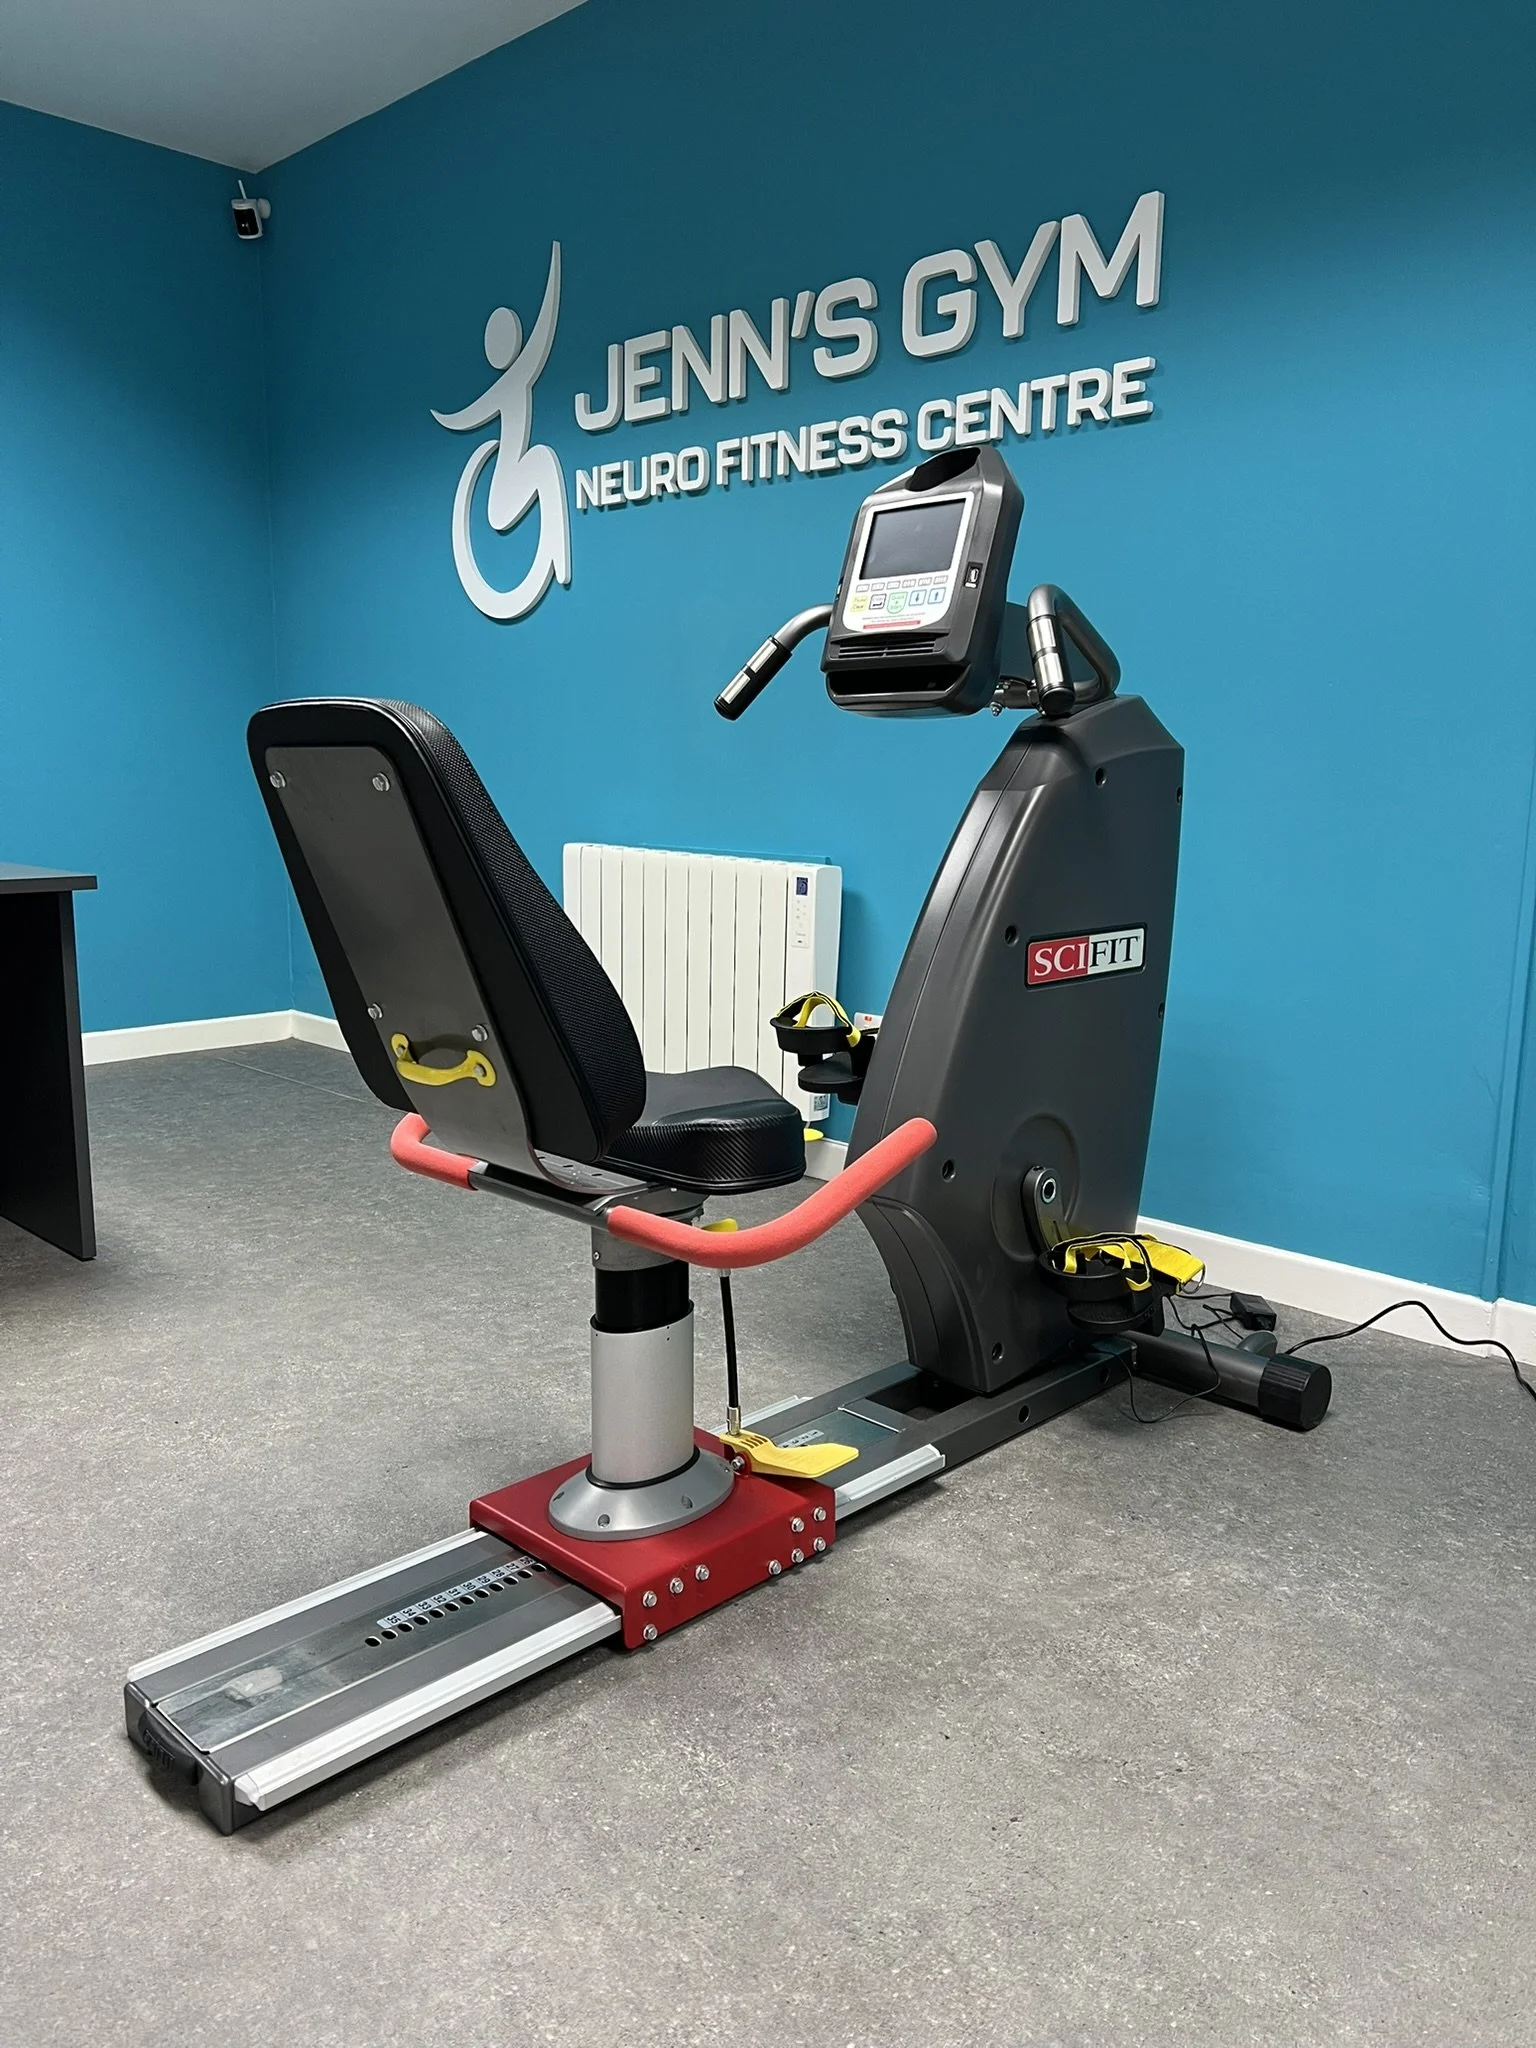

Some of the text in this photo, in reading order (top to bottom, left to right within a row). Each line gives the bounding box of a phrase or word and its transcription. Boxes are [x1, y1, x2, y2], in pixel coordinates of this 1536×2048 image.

[575, 190, 1165, 431] JENN'S GYM
[576, 356, 1156, 510] NEURO FITNESS CENTRE
[1034, 936, 1138, 977] SCIFIT
[418, 1602, 432, 1610] 33
[433, 1595, 447, 1603] 32
[387, 1615, 401, 1624] 35
